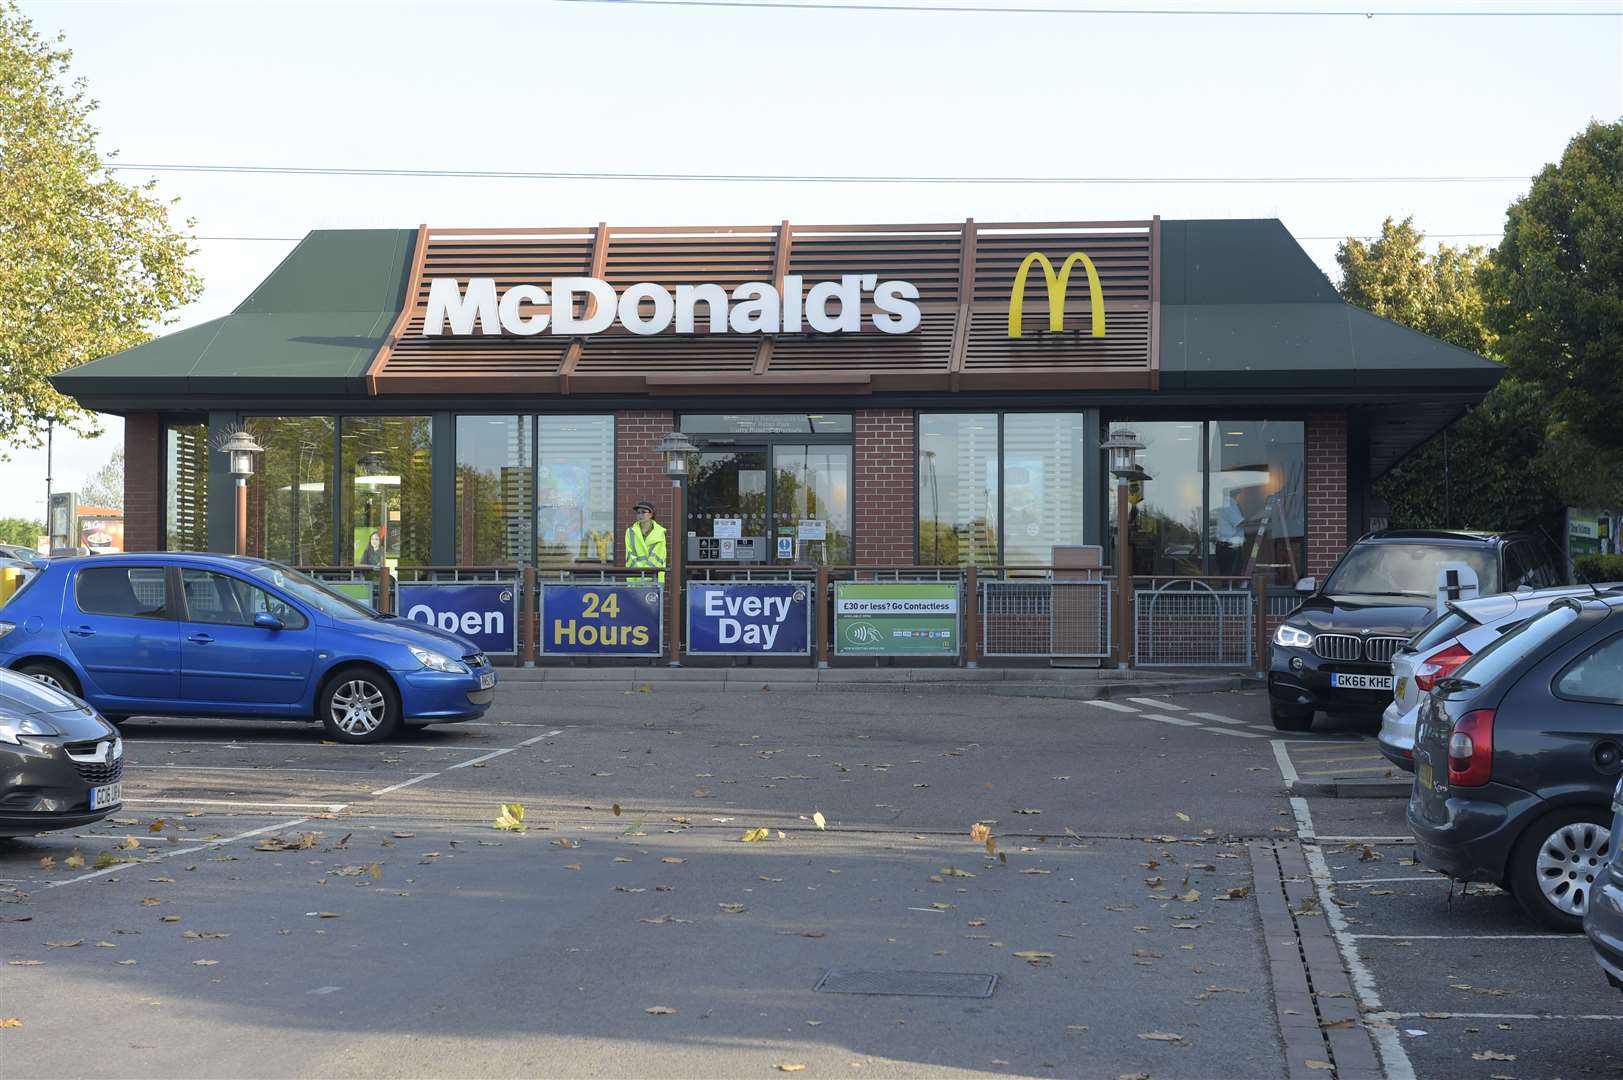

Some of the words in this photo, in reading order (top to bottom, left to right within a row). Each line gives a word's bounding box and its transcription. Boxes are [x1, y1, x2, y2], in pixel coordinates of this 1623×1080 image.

[423, 274, 922, 337] McDonald's
[581, 592, 620, 618] 24
[705, 590, 792, 623] Every
[844, 602, 858, 610] £30
[870, 602, 891, 610] less?
[892, 602, 903, 610] Go
[904, 602, 950, 610] Contactless
[407, 604, 504, 635] Open
[554, 619, 649, 645] Hours
[718, 618, 780, 650] Day
[1338, 675, 1366, 687] GK66
[1369, 676, 1391, 688] KHE
